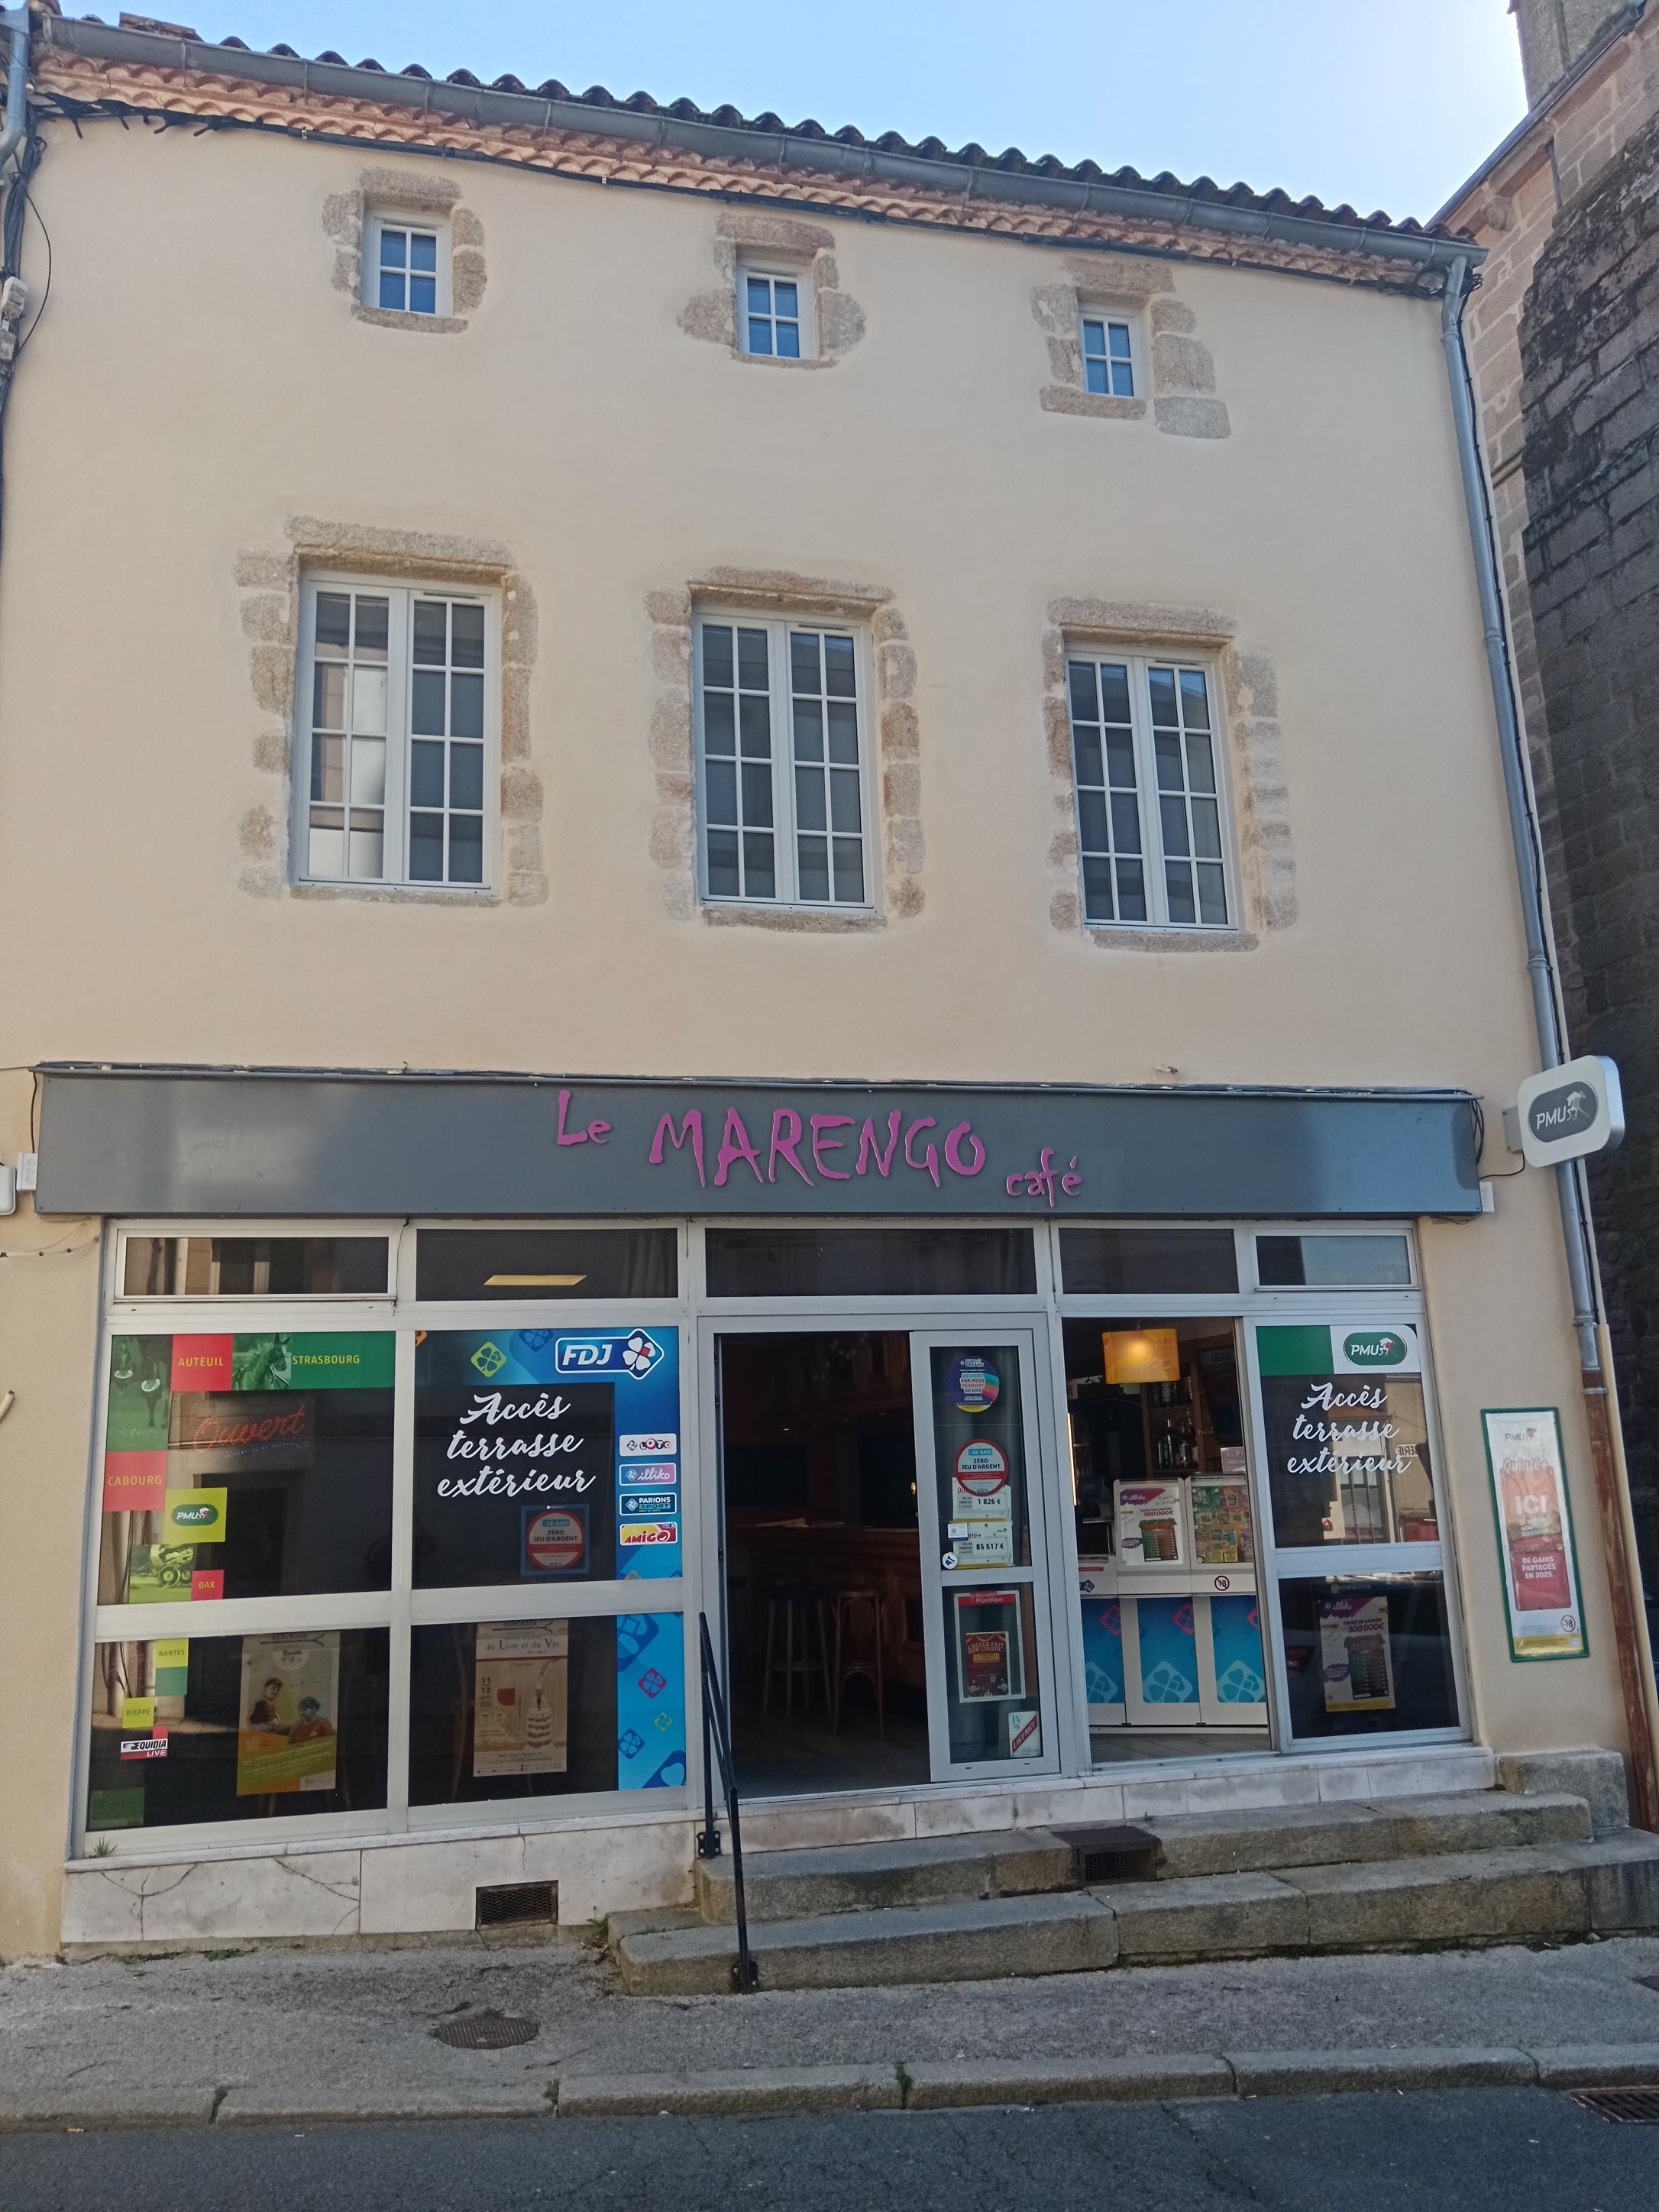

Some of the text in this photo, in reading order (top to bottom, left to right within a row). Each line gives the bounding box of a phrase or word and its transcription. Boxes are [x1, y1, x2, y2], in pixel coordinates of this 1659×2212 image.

[1535, 1105, 1567, 1130] PMU
[557, 1088, 1083, 1208] Le MARENGO café
[561, 1344, 613, 1366] FDJ
[1350, 1344, 1380, 1357] PMU
[177, 1357, 225, 1367] AUTEUIL
[292, 1354, 361, 1365] STRASBOURG
[1301, 1382, 1388, 1412] Accès
[458, 1392, 571, 1426] Accès
[1291, 1413, 1400, 1443] terrasse
[446, 1429, 584, 1460] terrasse
[639, 1437, 671, 1450] LOTO
[1505, 1434, 1525, 1442] PMU
[1286, 1447, 1412, 1475] extérieur
[1502, 1457, 1548, 1474] Quinté+
[637, 1467, 671, 1480] illiko
[108, 1475, 163, 1487] CABOURG
[437, 1465, 597, 1498] extérieur
[1515, 1495, 1547, 1515] ICI
[176, 1512, 199, 1521] PMU
[199, 1581, 215, 1590] DAX
[499, 1639, 519, 1651] Livre
[545, 1638, 560, 1648] Vin
[158, 1648, 186, 1657] NANTES
[125, 1707, 152, 1717] DIEPPE
